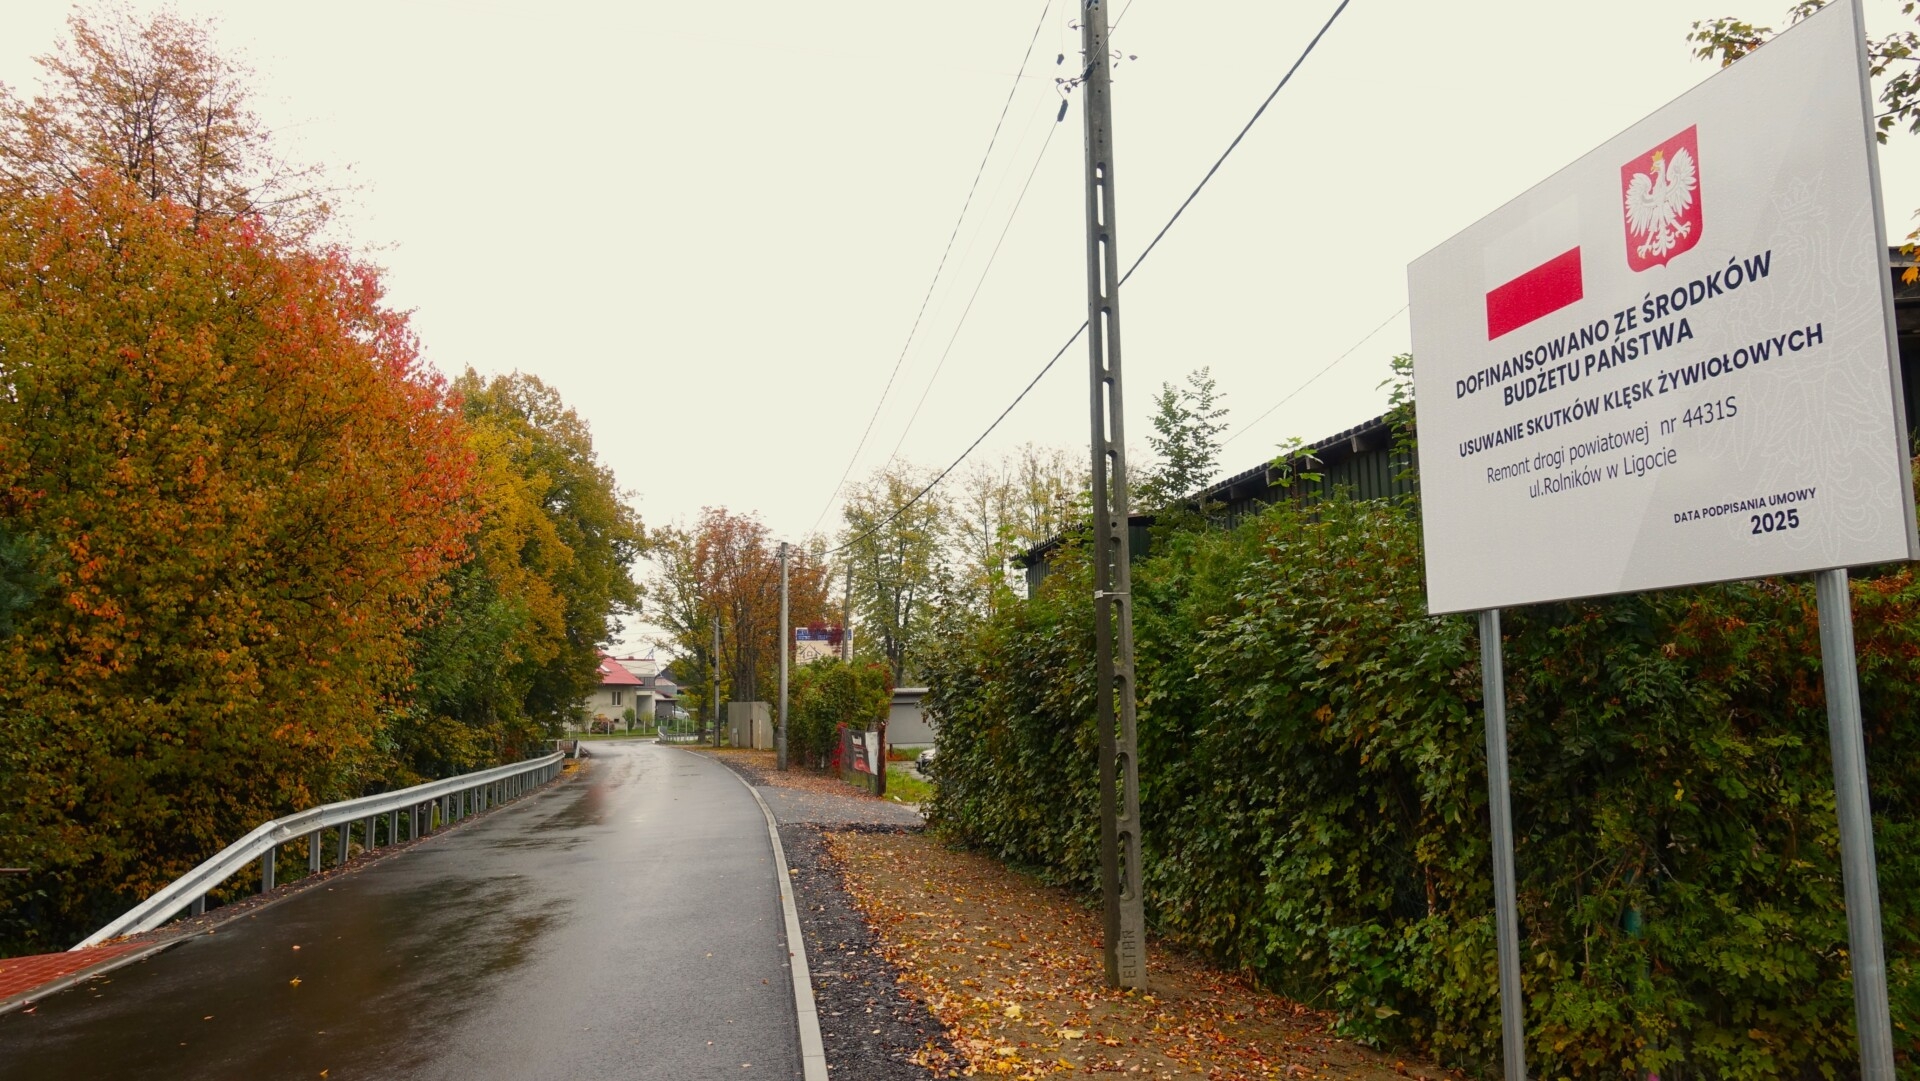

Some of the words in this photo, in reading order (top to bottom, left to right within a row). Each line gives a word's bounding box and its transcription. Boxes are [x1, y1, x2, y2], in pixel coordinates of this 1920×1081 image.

[1456, 319, 1609, 399] DOFINANSOWANO
[1614, 305, 1638, 337] ZE
[1641, 250, 1772, 325] ŚRODKÓW
[1503, 359, 1580, 407] BUDŻETU
[1584, 318, 1694, 377] PAŃSTWA
[1459, 422, 1524, 458] USUWANIE
[1526, 397, 1600, 436] SKUTKÓW
[1603, 379, 1655, 412] KLĘSK
[1657, 323, 1824, 395] ŻYWIOŁOWYCH
[1487, 457, 1530, 484] Remont
[1533, 447, 1566, 473] drogi
[1569, 421, 1650, 466] powiatowej
[1660, 416, 1677, 436] nr
[1682, 396, 1738, 429] 4431S
[1529, 465, 1602, 499] ul.Rolników
[1606, 464, 1619, 480] w
[1623, 446, 1678, 477] Ligocie
[1673, 509, 1701, 524] DATA
[1702, 496, 1766, 519] PODPISANIA
[1768, 487, 1817, 508] UMOWY
[1750, 508, 1800, 535] 2025
